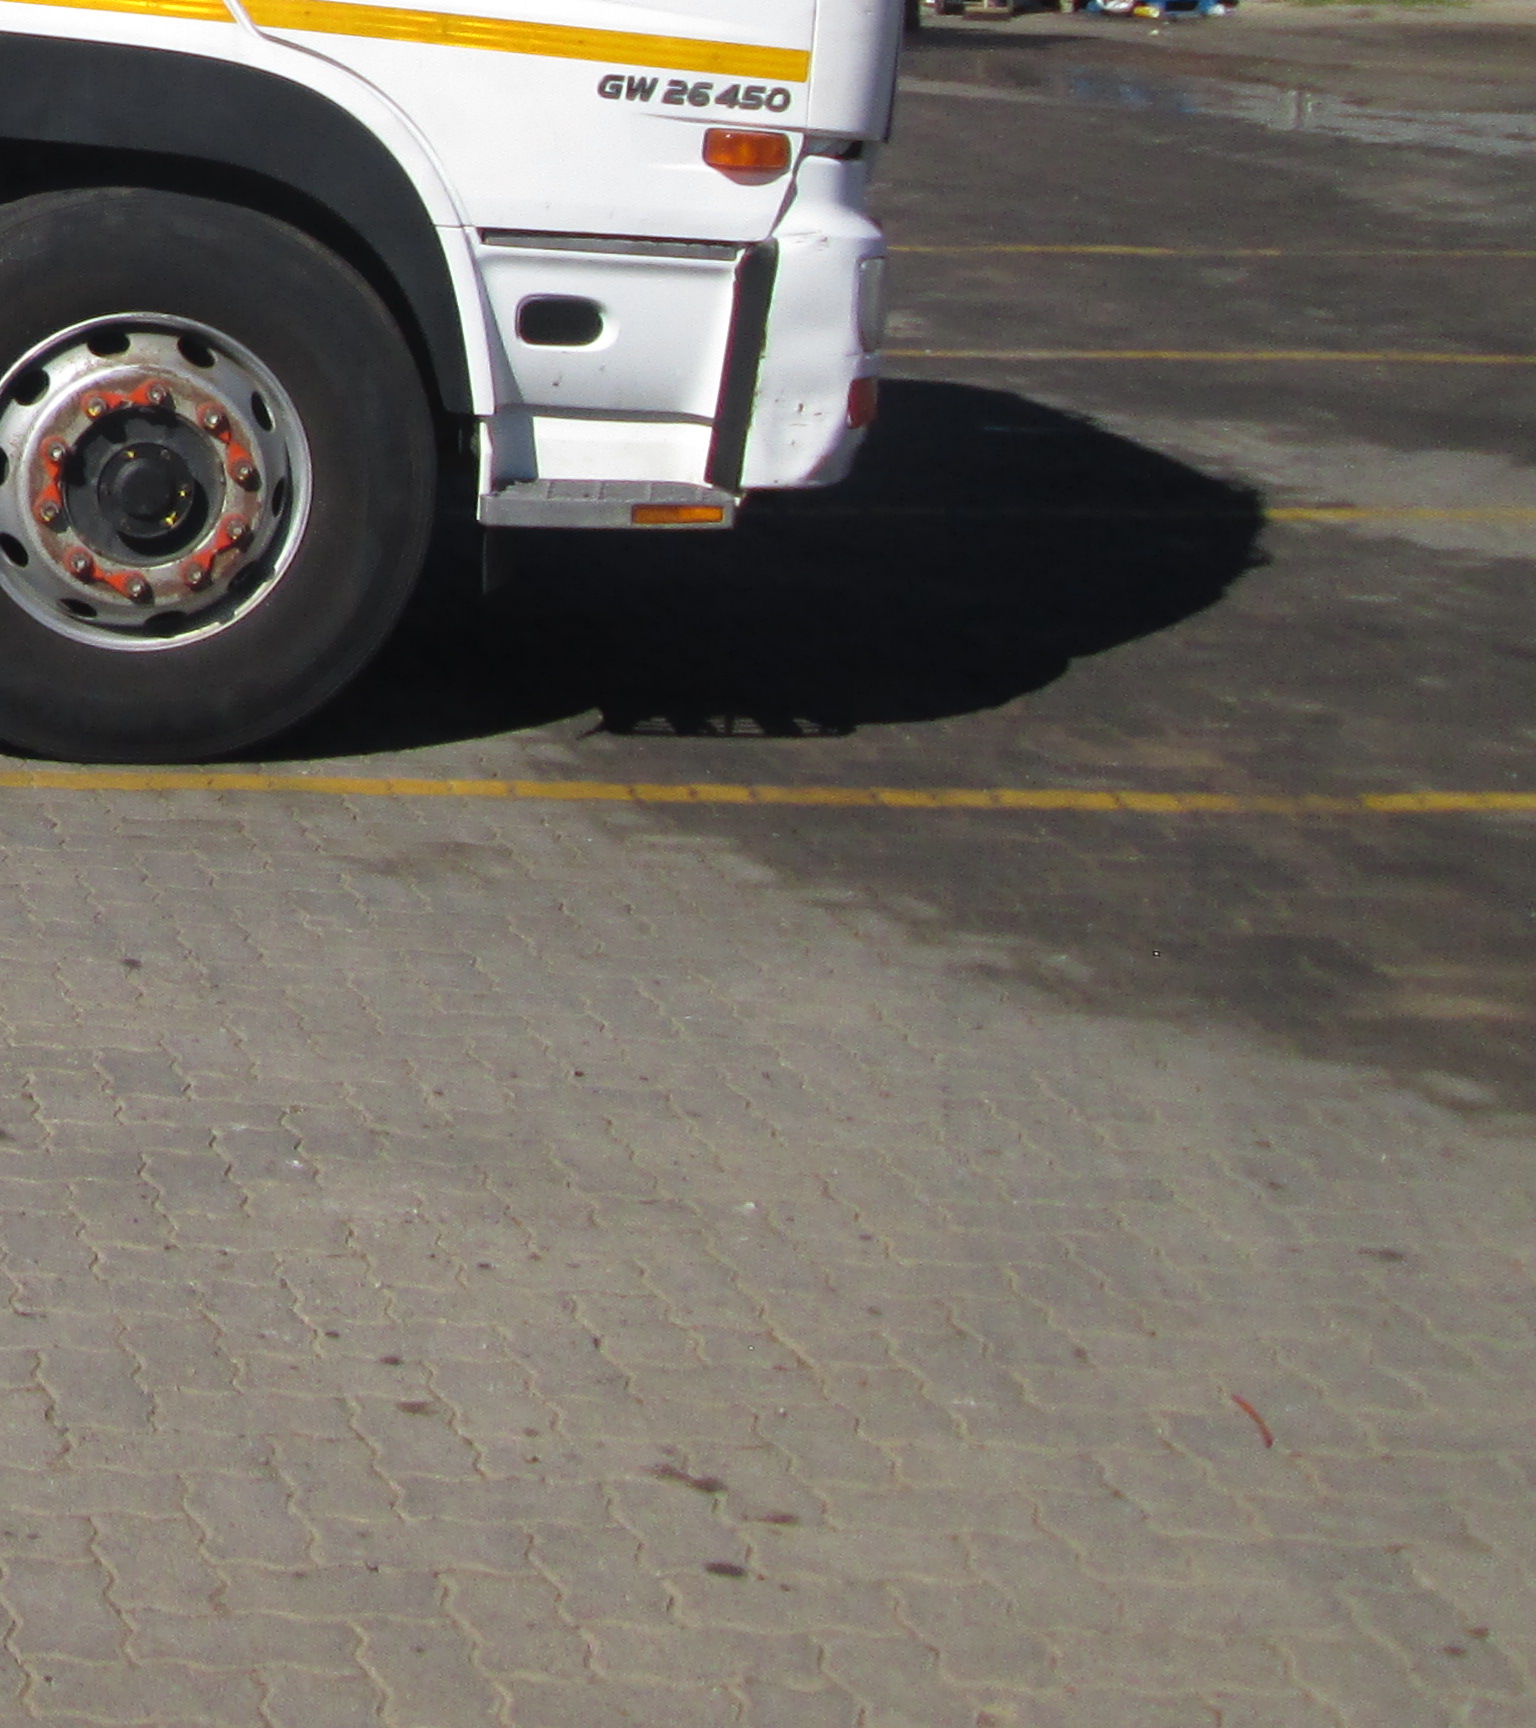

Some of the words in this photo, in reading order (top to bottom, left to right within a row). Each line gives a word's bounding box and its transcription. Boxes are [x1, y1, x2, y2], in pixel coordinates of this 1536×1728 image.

[597, 74, 659, 102] GW
[661, 79, 713, 108] 26
[714, 83, 792, 113] 450
